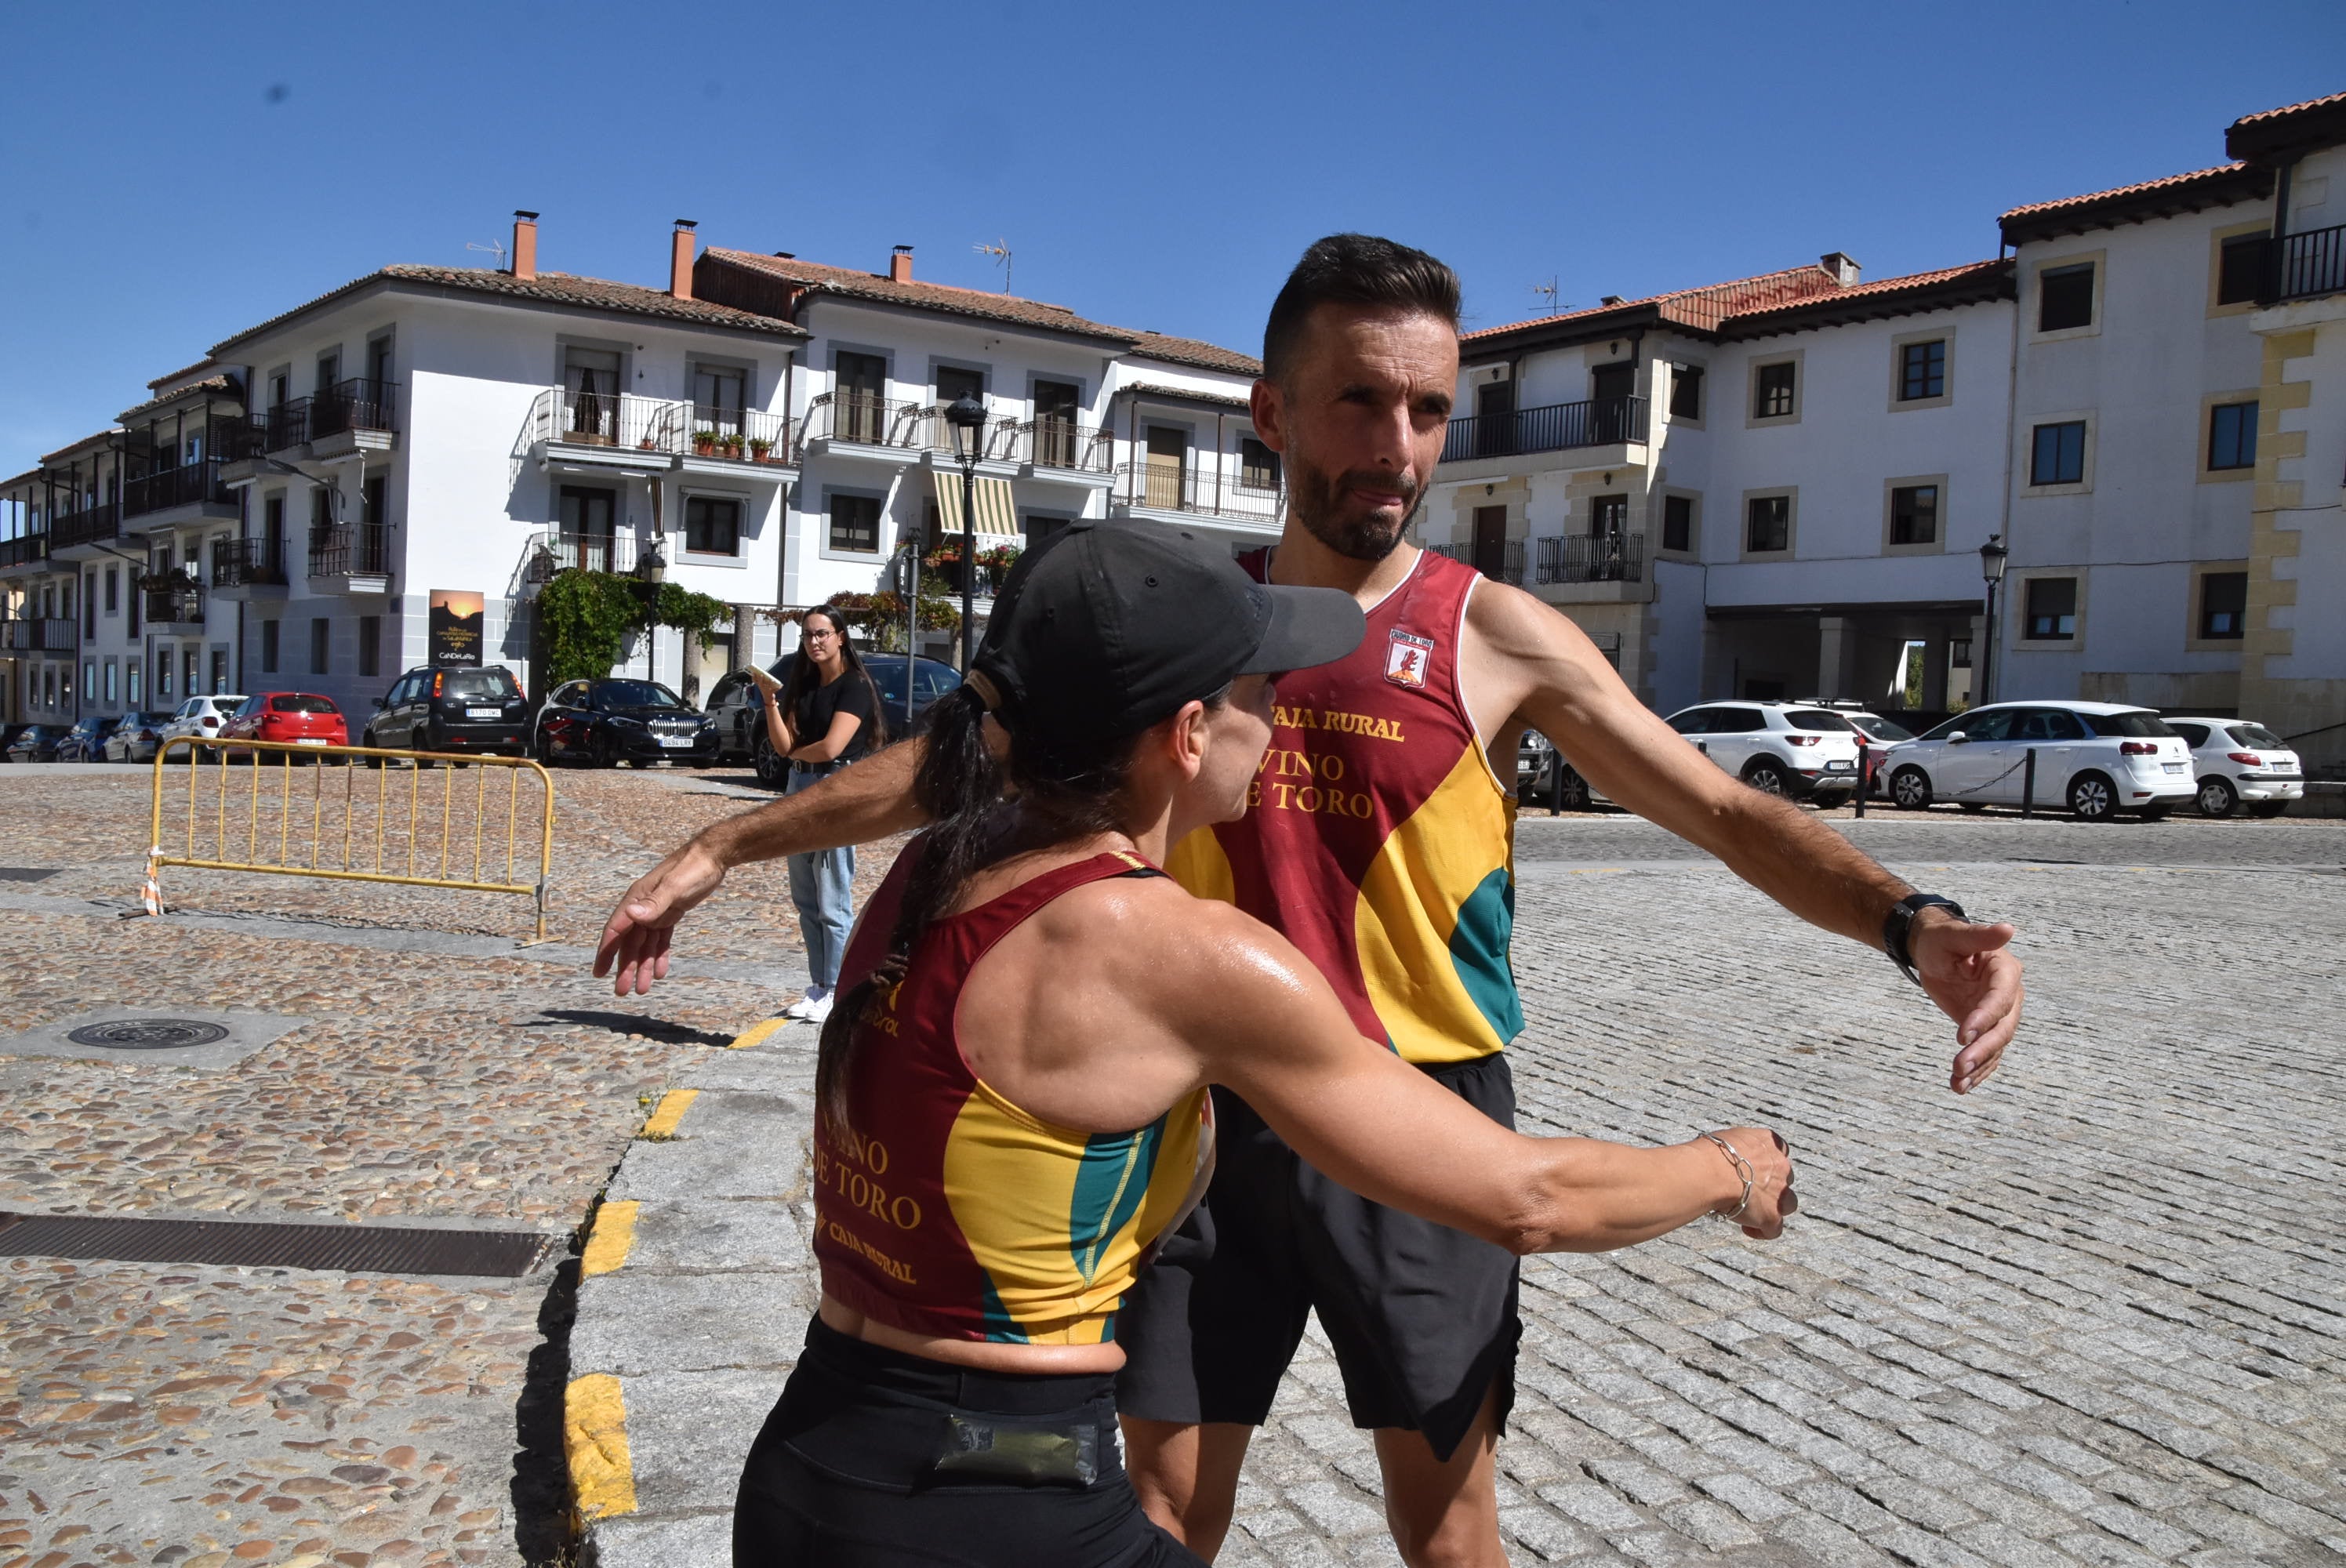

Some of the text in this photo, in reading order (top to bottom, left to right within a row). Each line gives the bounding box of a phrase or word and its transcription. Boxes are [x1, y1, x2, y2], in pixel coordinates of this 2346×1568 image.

[1419, 638, 1432, 648] TORO
[1270, 705, 1405, 742] AJA RURAL
[1258, 748, 1345, 782] VINO
[1247, 781, 1373, 819] E TORO
[835, 1160, 922, 1230] TORO
[829, 1221, 864, 1255] CAJA
